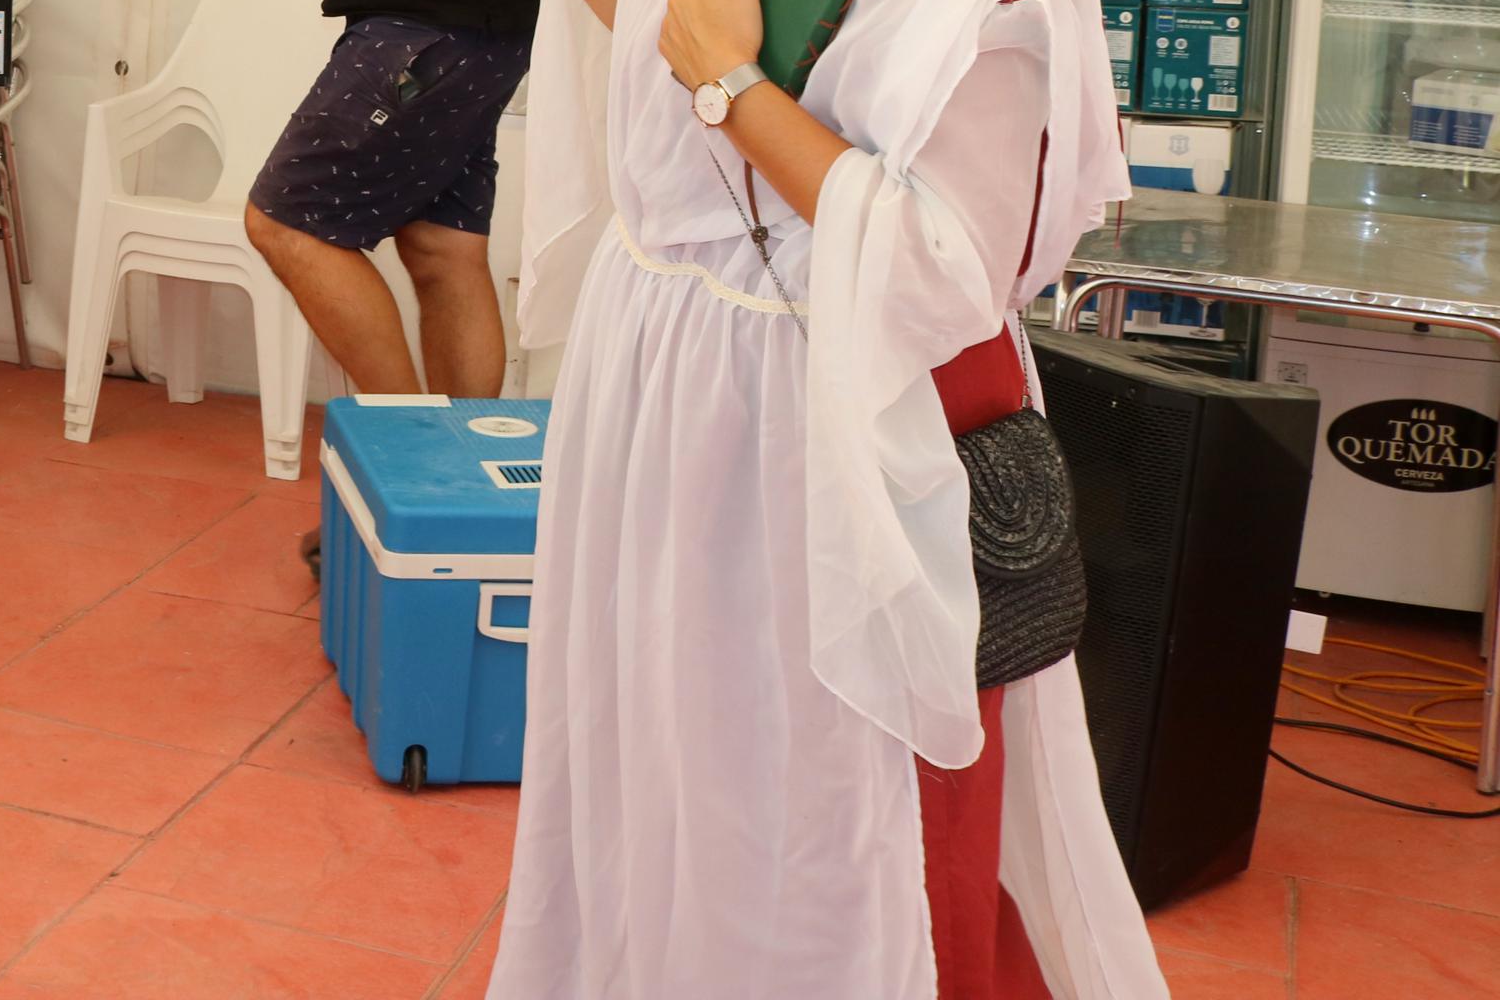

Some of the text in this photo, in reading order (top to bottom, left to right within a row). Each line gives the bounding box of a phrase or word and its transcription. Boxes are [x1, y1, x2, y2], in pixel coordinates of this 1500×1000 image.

[1388, 420, 1459, 446] TOR
[1337, 436, 1496, 471] QUEMADA
[1395, 468, 1444, 481] CERVEZA
